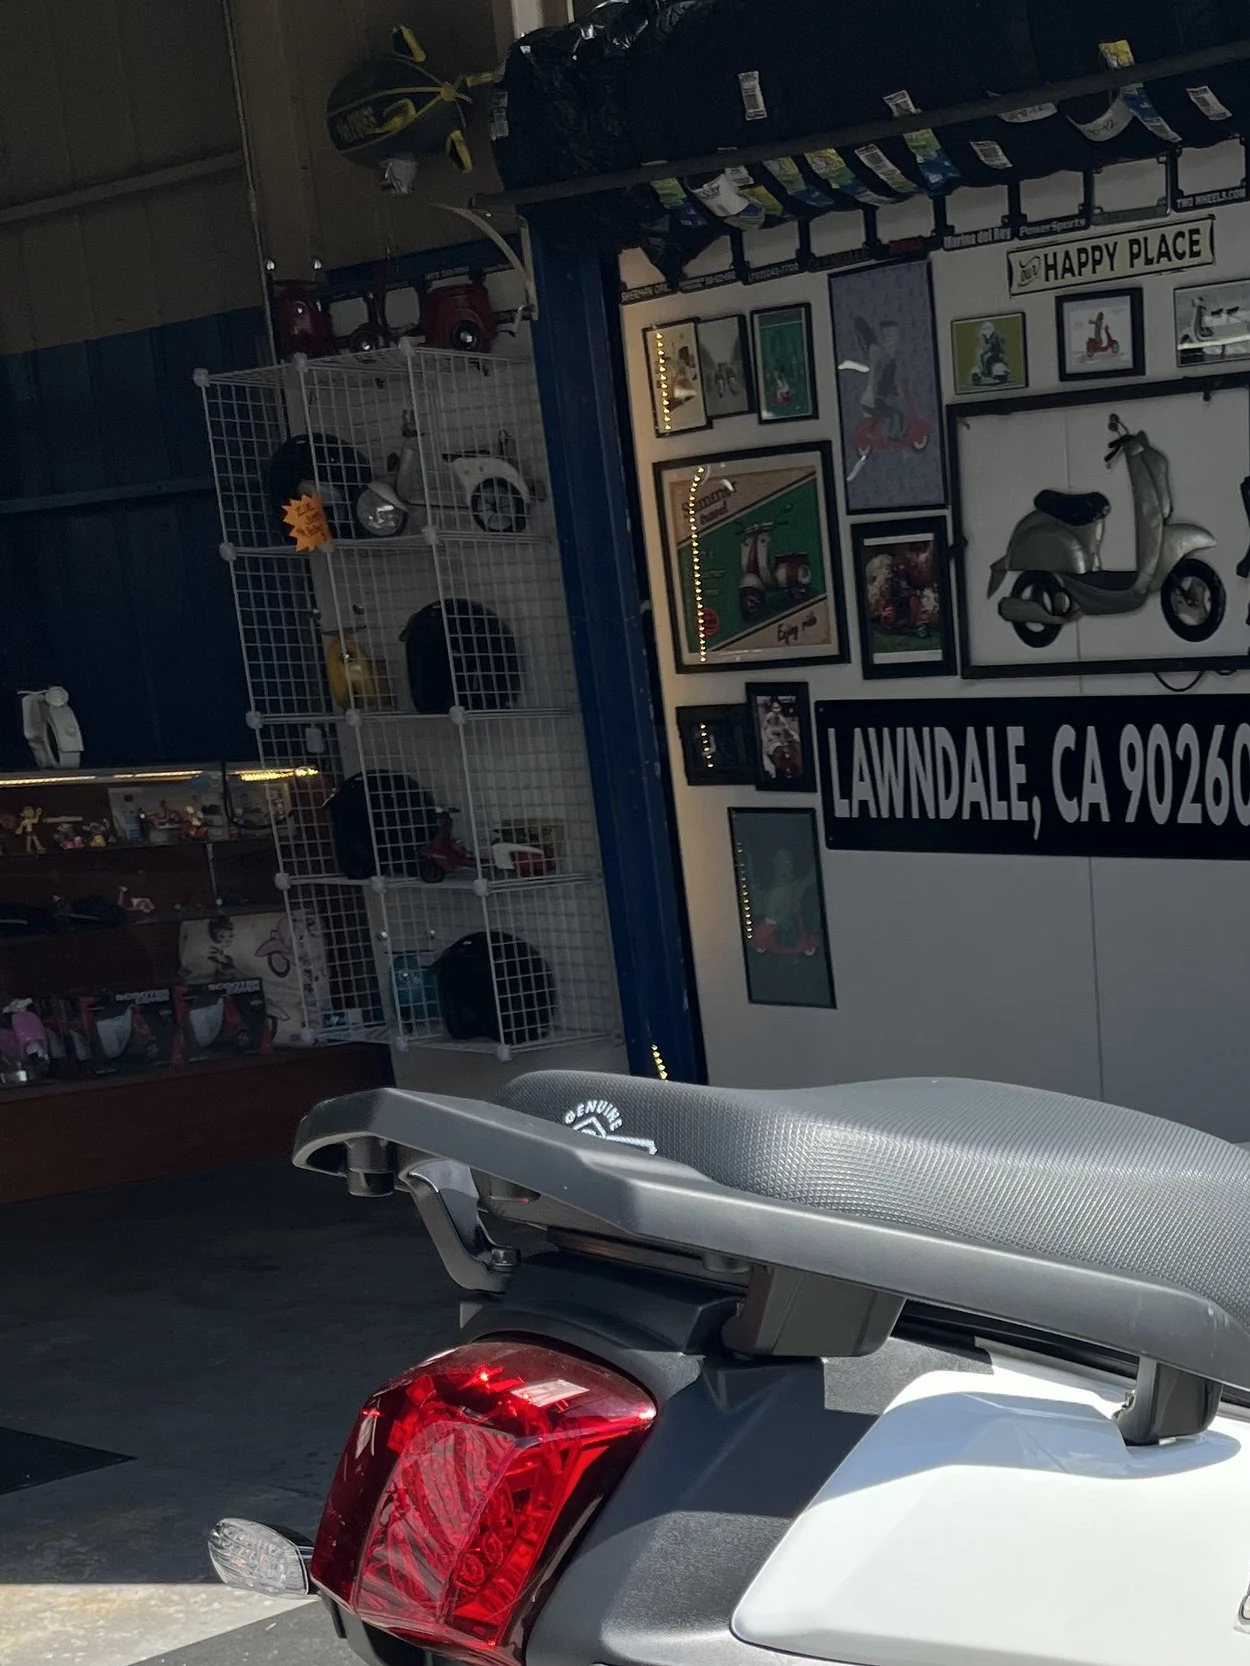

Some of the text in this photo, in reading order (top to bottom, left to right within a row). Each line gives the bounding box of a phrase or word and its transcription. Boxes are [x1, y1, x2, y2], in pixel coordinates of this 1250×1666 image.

[1044, 241, 1118, 282] HAPPY
[1128, 228, 1201, 269] PLACE
[827, 725, 1043, 841] LAWNDALE,
[1052, 723, 1110, 823] CA
[564, 1099, 623, 1132] GENUINE
